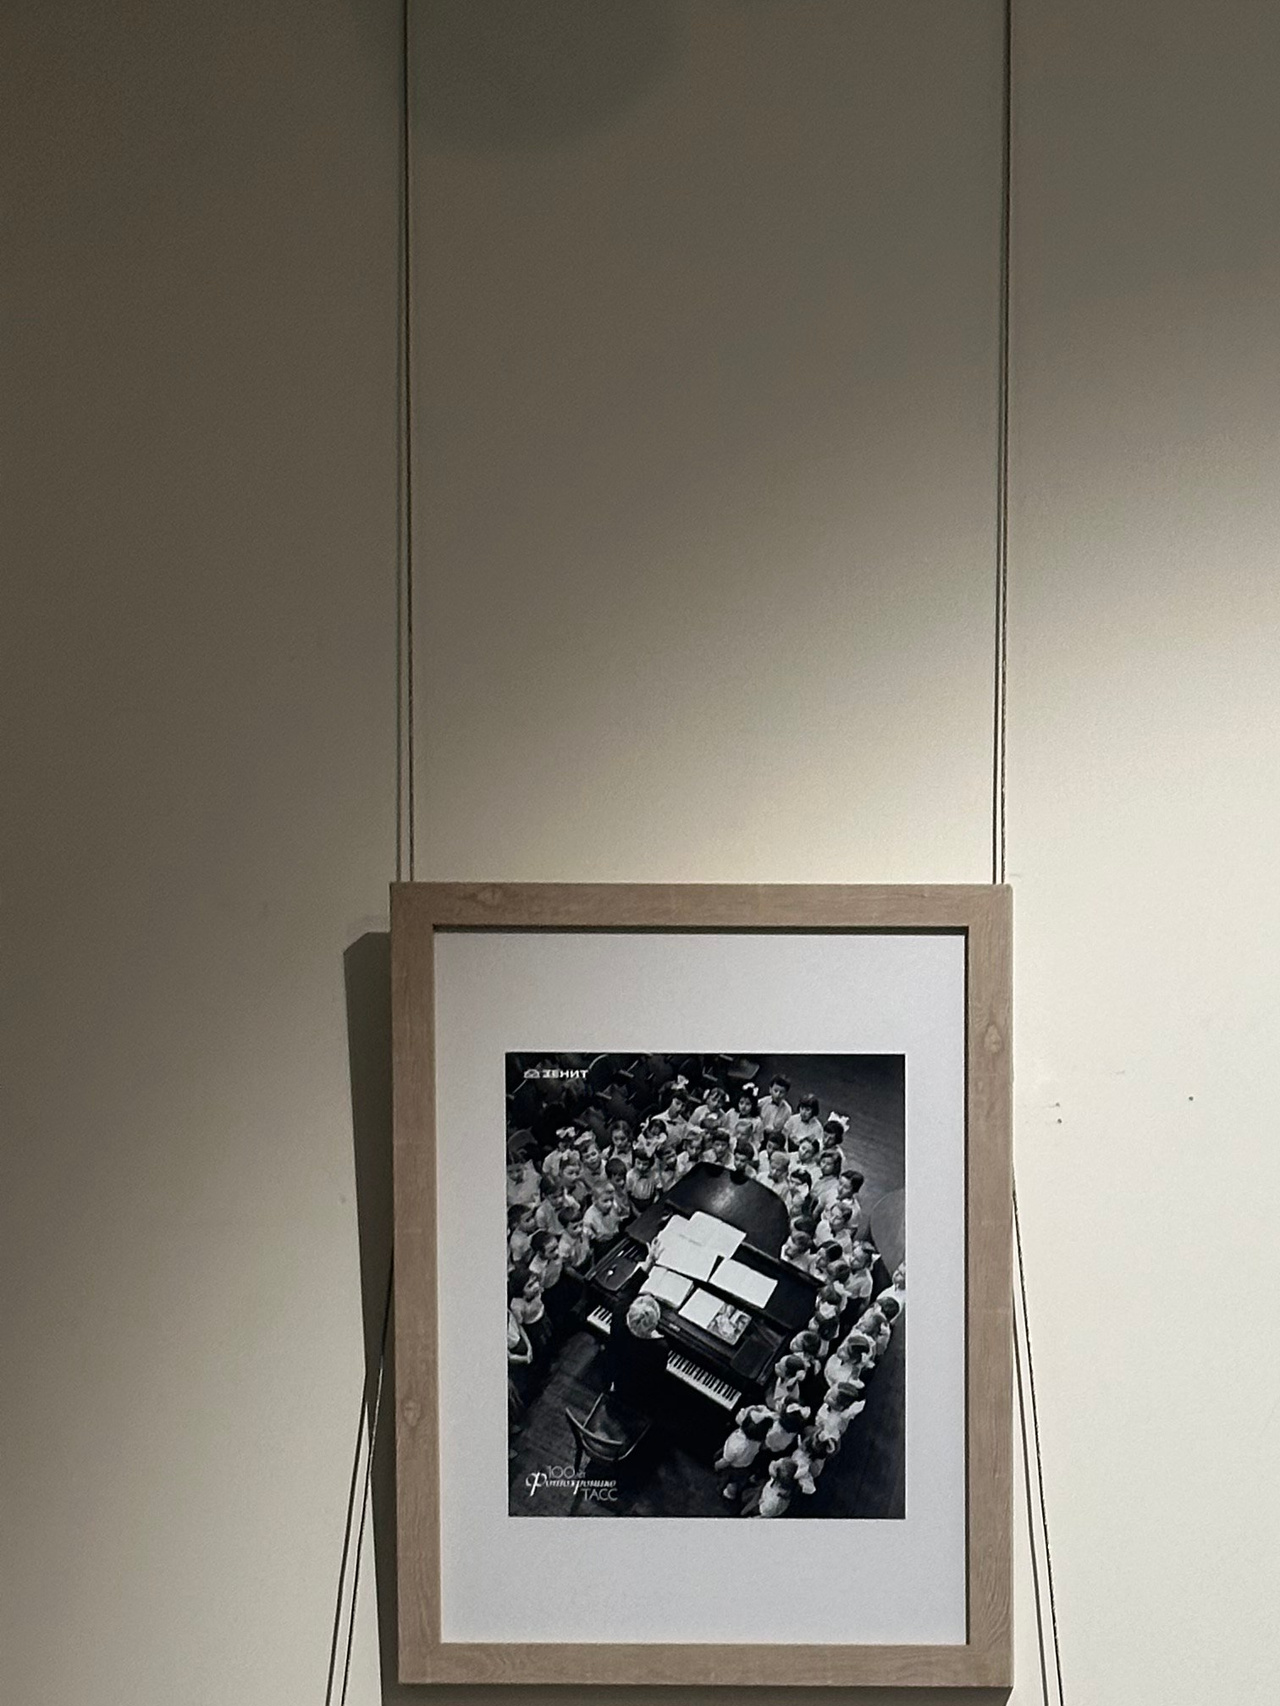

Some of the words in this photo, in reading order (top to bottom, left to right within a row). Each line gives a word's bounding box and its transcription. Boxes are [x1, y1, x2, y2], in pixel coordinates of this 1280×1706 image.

[542, 1069, 589, 1079] ЗЕНИТ
[546, 1465, 576, 1479] 100
[581, 1488, 618, 1501] ТАСС
